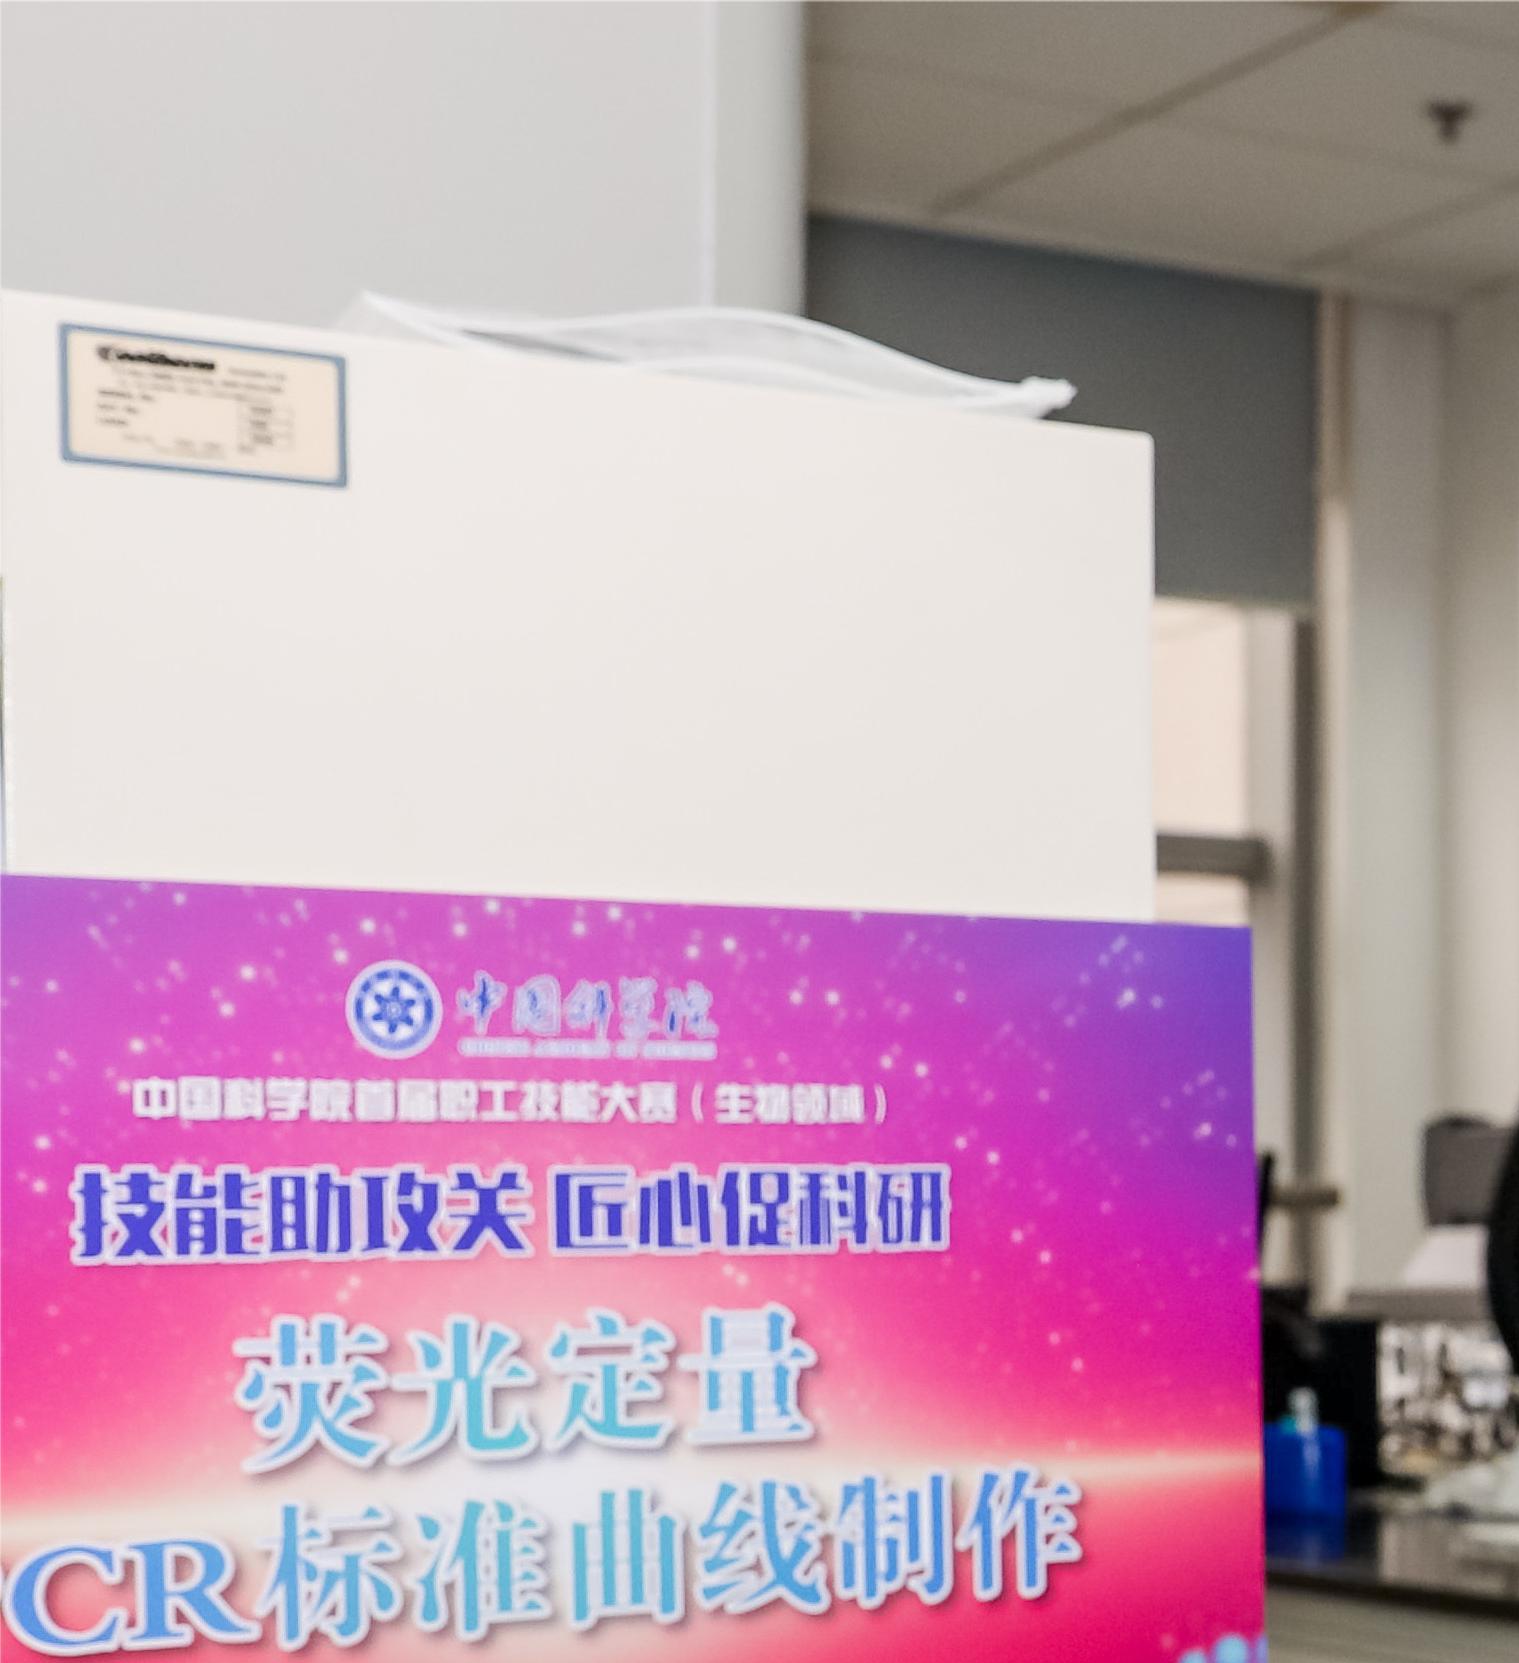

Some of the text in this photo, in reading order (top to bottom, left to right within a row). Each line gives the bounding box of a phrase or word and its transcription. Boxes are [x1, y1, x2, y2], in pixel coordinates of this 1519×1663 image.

[72, 1163, 951, 1265] 技能助攻关 匠心促科研
[234, 1304, 817, 1472] 荧光定量
